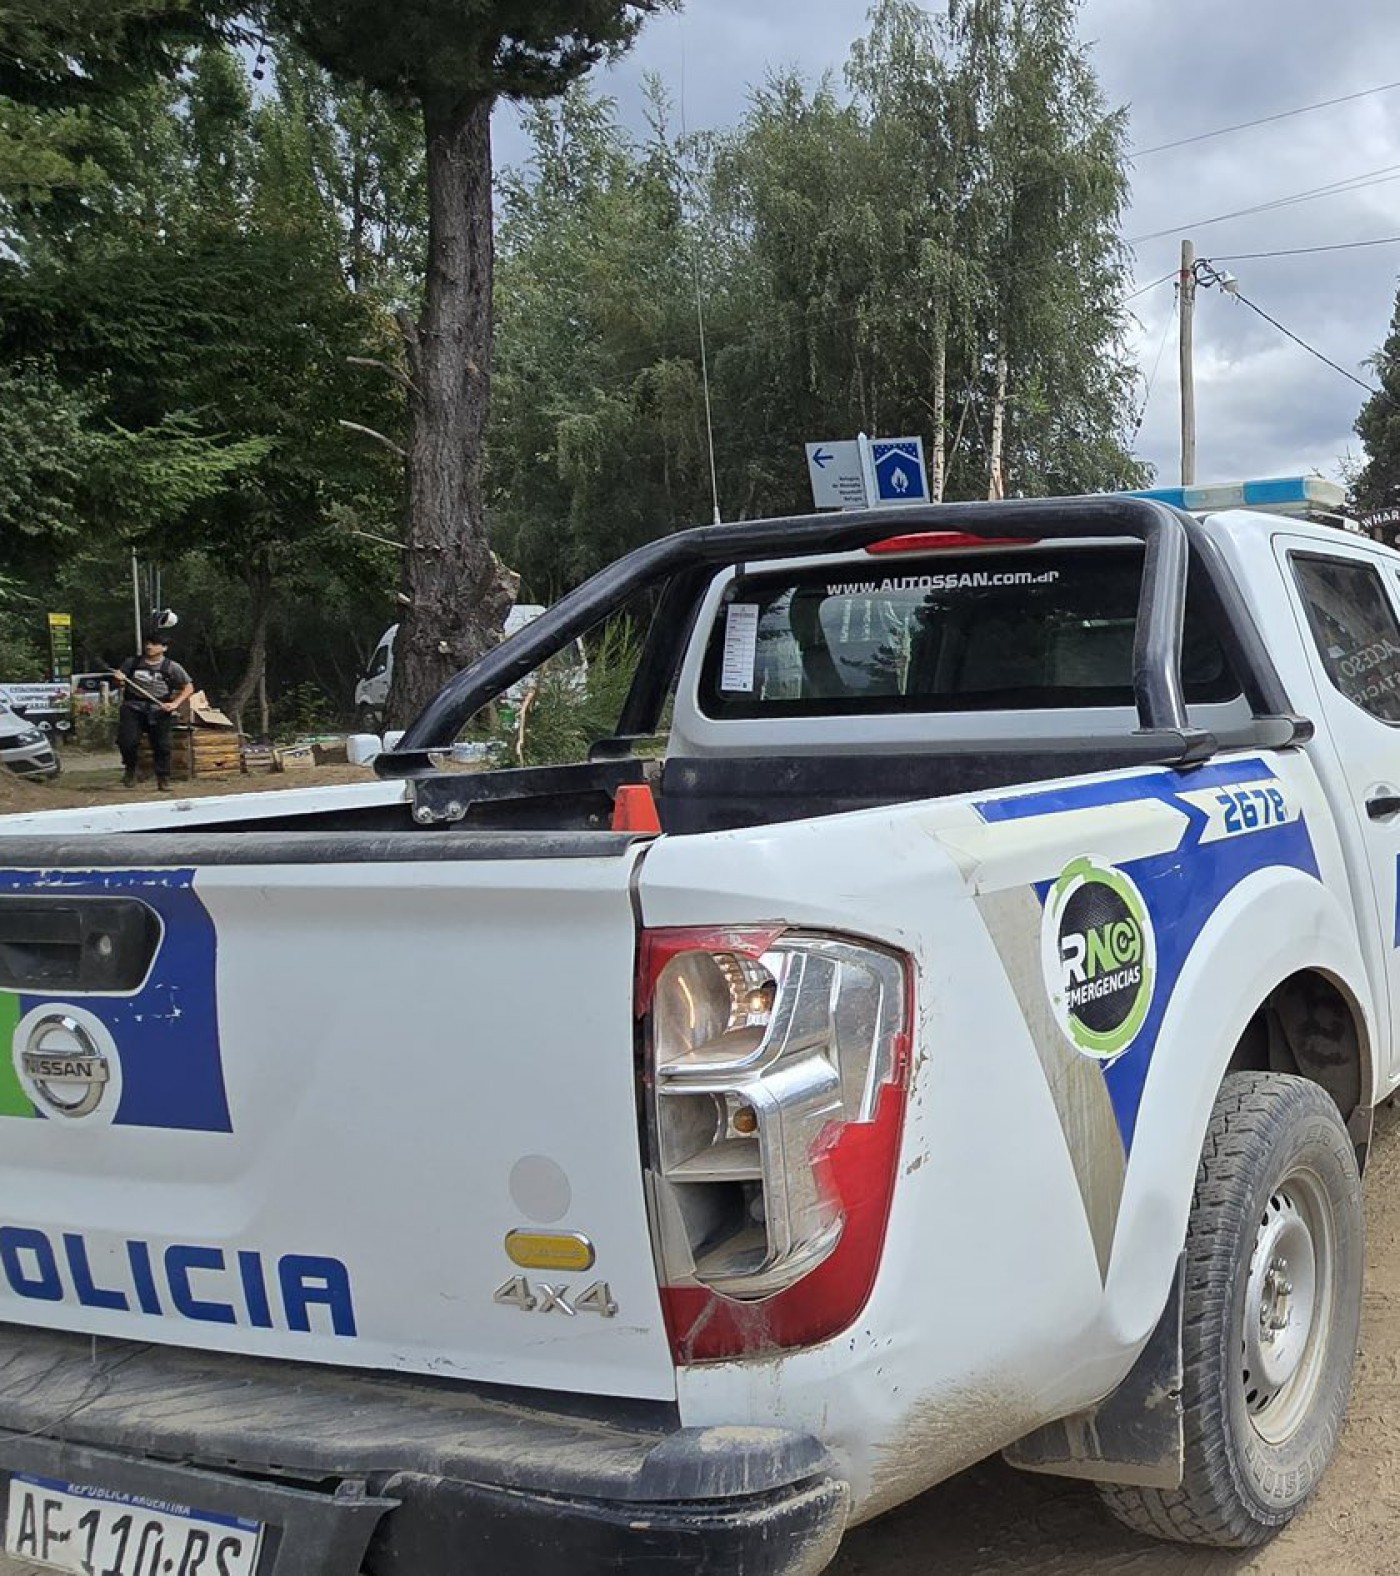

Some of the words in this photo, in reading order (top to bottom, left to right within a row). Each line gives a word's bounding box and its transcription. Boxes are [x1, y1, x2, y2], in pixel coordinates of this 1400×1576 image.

[1215, 787, 1286, 833] 2678
[26, 1059, 93, 1077] NISSAN
[0, 1225, 357, 1337] OLICIA
